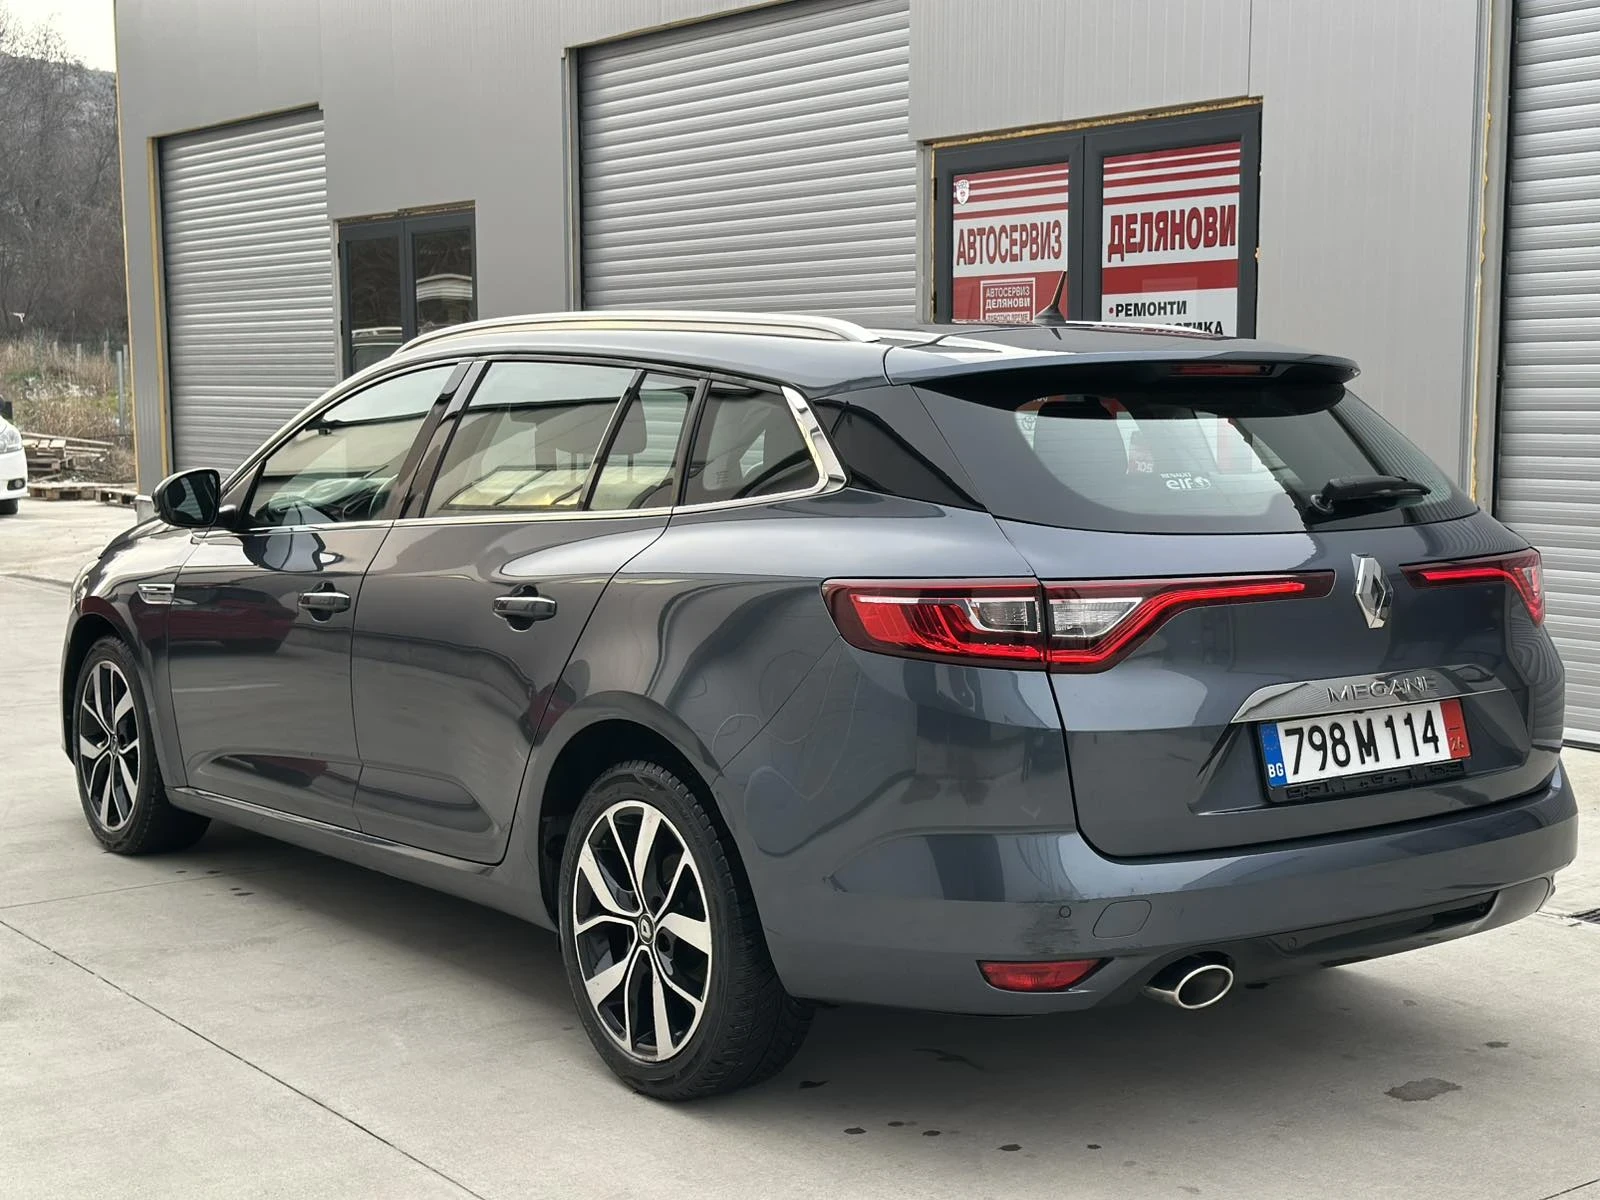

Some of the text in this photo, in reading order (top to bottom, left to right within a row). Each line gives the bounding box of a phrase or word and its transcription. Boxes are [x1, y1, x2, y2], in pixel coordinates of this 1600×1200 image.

[956, 219, 1062, 266] АВТОСЕРВИЗ
[1107, 204, 1237, 263] ДЕЛЯНОВИ
[985, 286, 1030, 298] АВТОСЕРВИЗ
[985, 297, 1031, 310] ДЕЛЯНОВИ
[1115, 300, 1187, 318] РЕМОНТИ
[1326, 676, 1438, 704] MEGANE
[1267, 763, 1285, 779] BG
[1284, 722, 1351, 776] 798
[1384, 709, 1440, 760] 114
